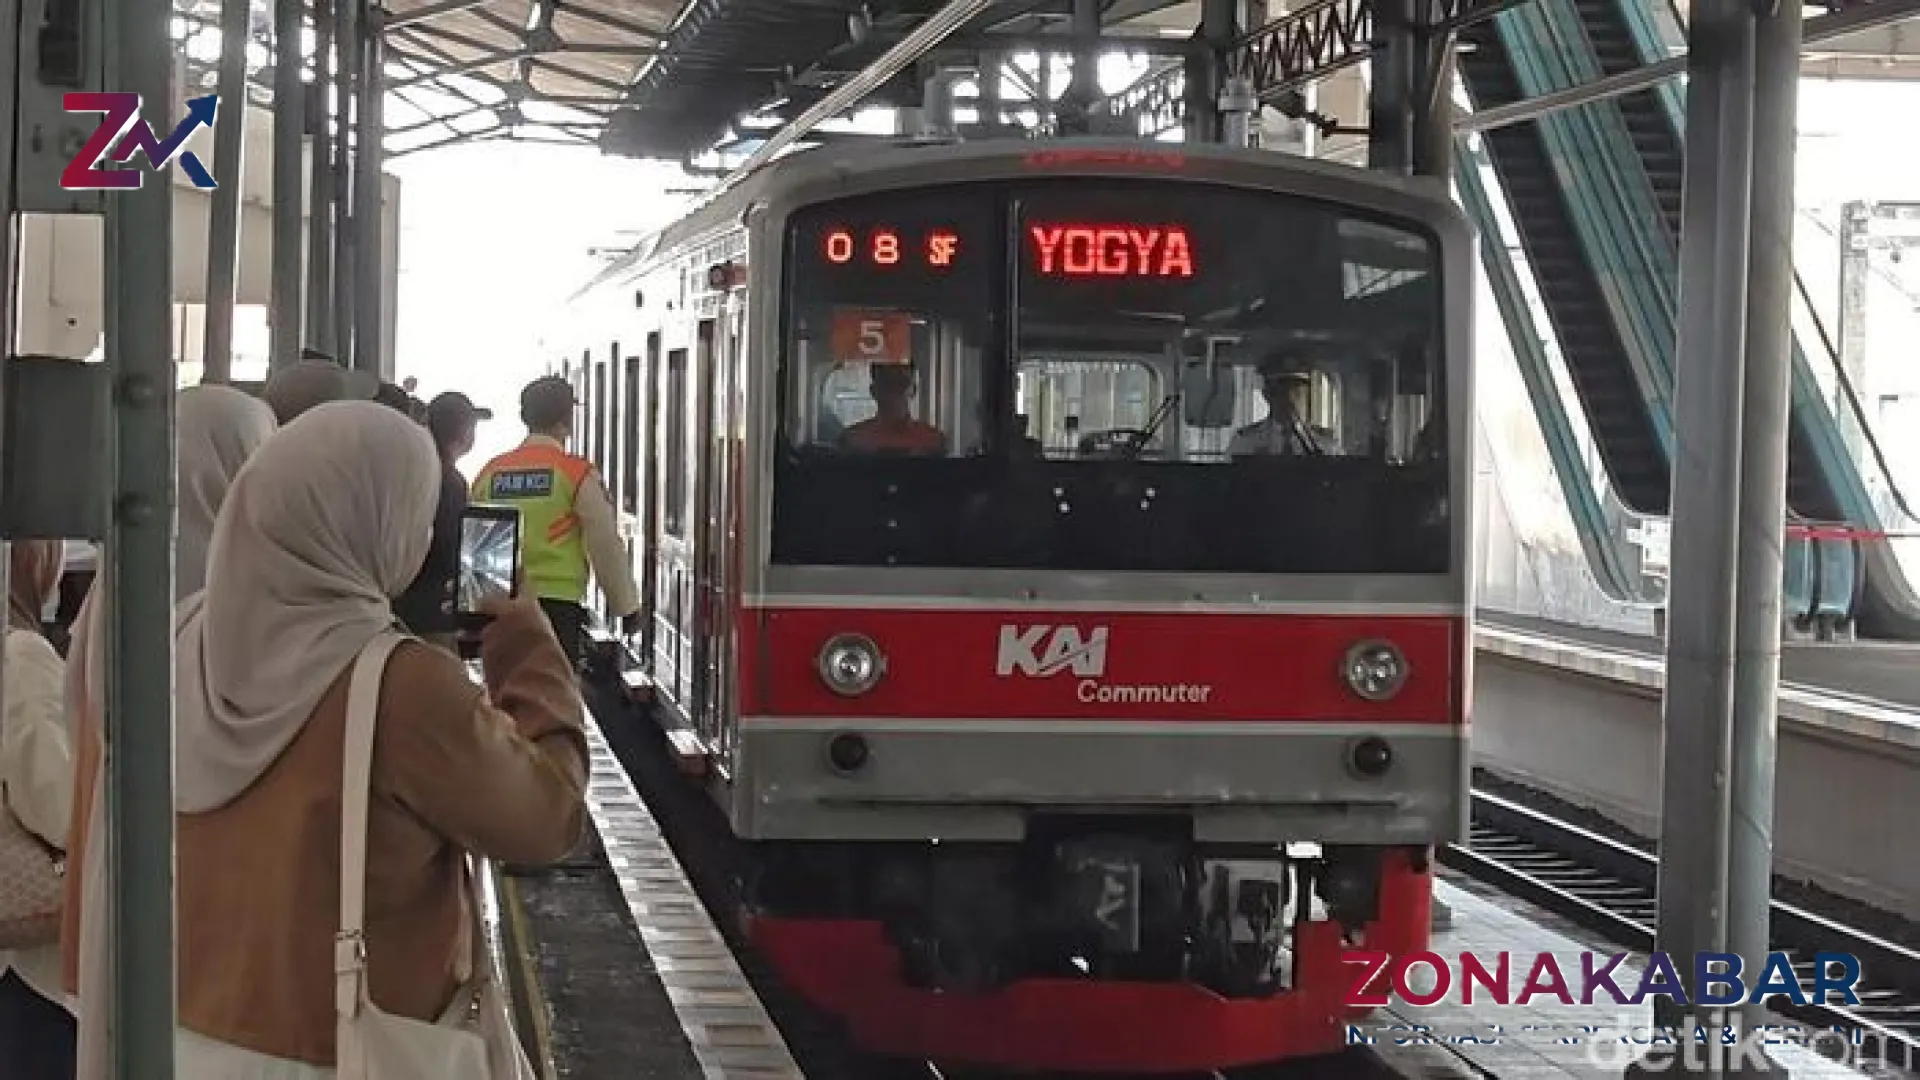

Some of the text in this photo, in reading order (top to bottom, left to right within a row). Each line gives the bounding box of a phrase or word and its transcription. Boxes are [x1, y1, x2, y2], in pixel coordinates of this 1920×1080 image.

[1031, 226, 1193, 276] YOGYA
[857, 320, 885, 355] 5
[997, 624, 1109, 677] KAI
[1077, 679, 1212, 703] Commuter
